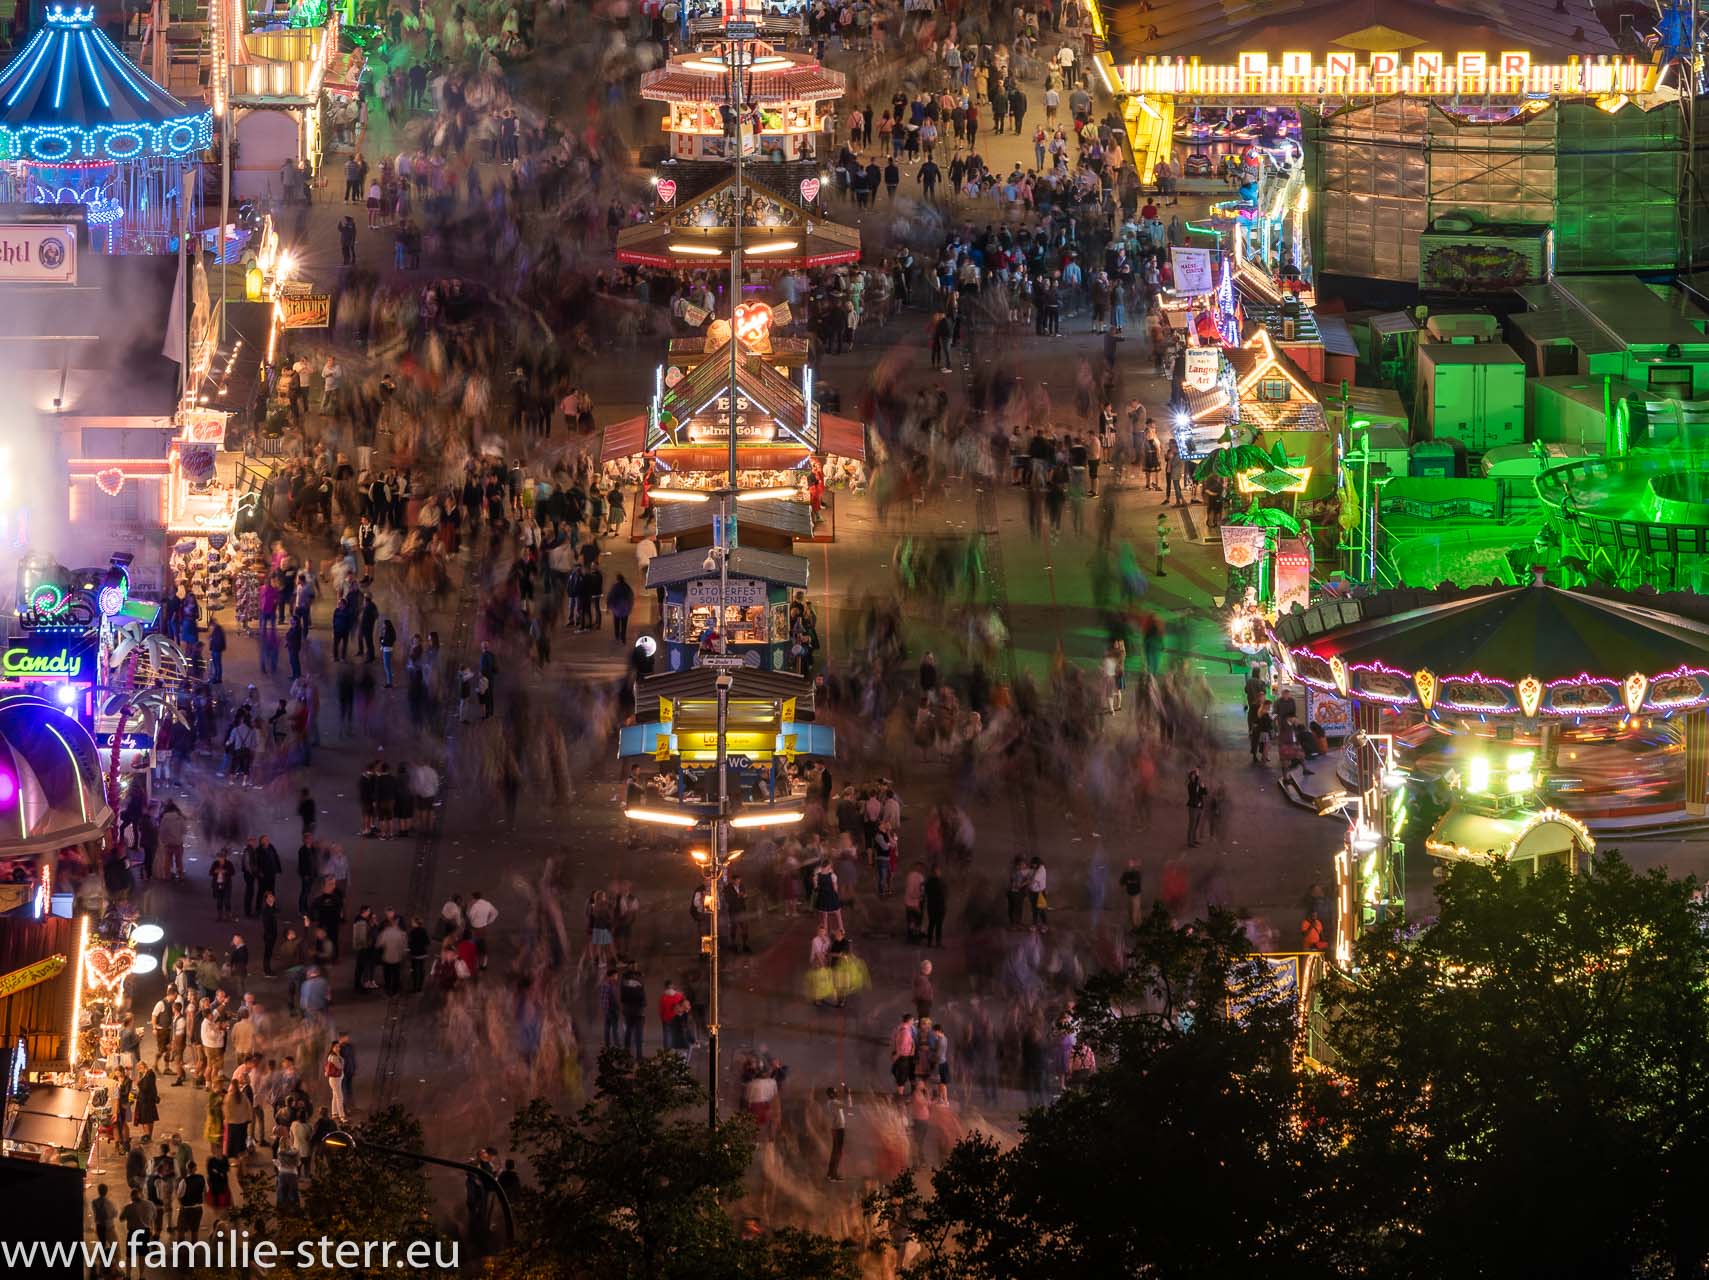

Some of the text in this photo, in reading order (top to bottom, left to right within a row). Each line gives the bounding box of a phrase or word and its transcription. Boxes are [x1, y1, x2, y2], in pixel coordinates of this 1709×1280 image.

[1244, 55, 1525, 74] LINDNER
[0, 241, 31, 266] htl
[3, 648, 81, 676] Candy
[729, 758, 749, 768] WC
